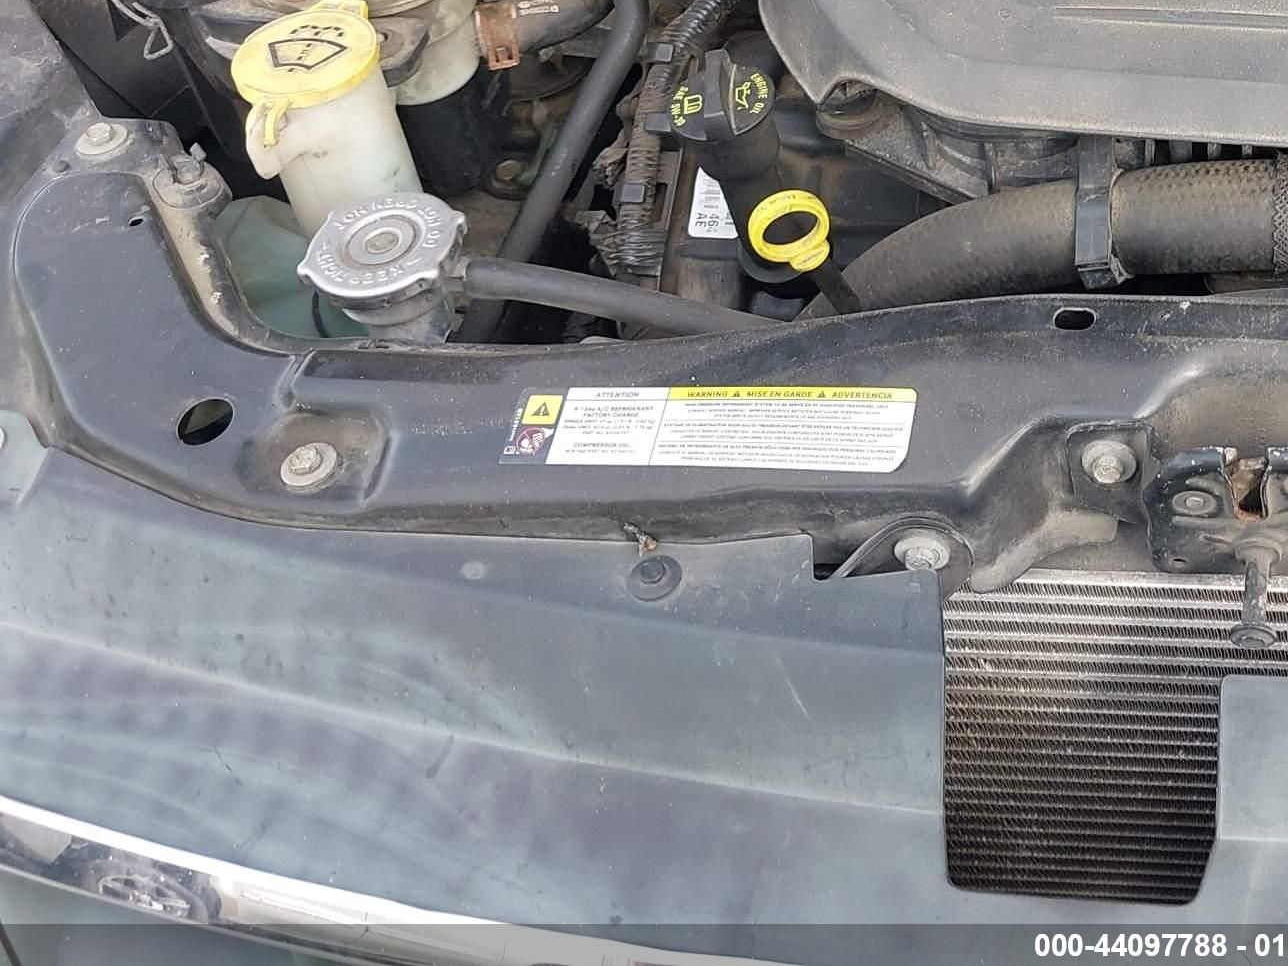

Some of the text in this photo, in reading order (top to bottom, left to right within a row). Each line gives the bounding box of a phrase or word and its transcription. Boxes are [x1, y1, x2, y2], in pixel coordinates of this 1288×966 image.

[672, 85, 689, 101] SAE
[748, 72, 769, 114] ENGINE OIL
[831, 391, 893, 400] ADVERTENCIA
